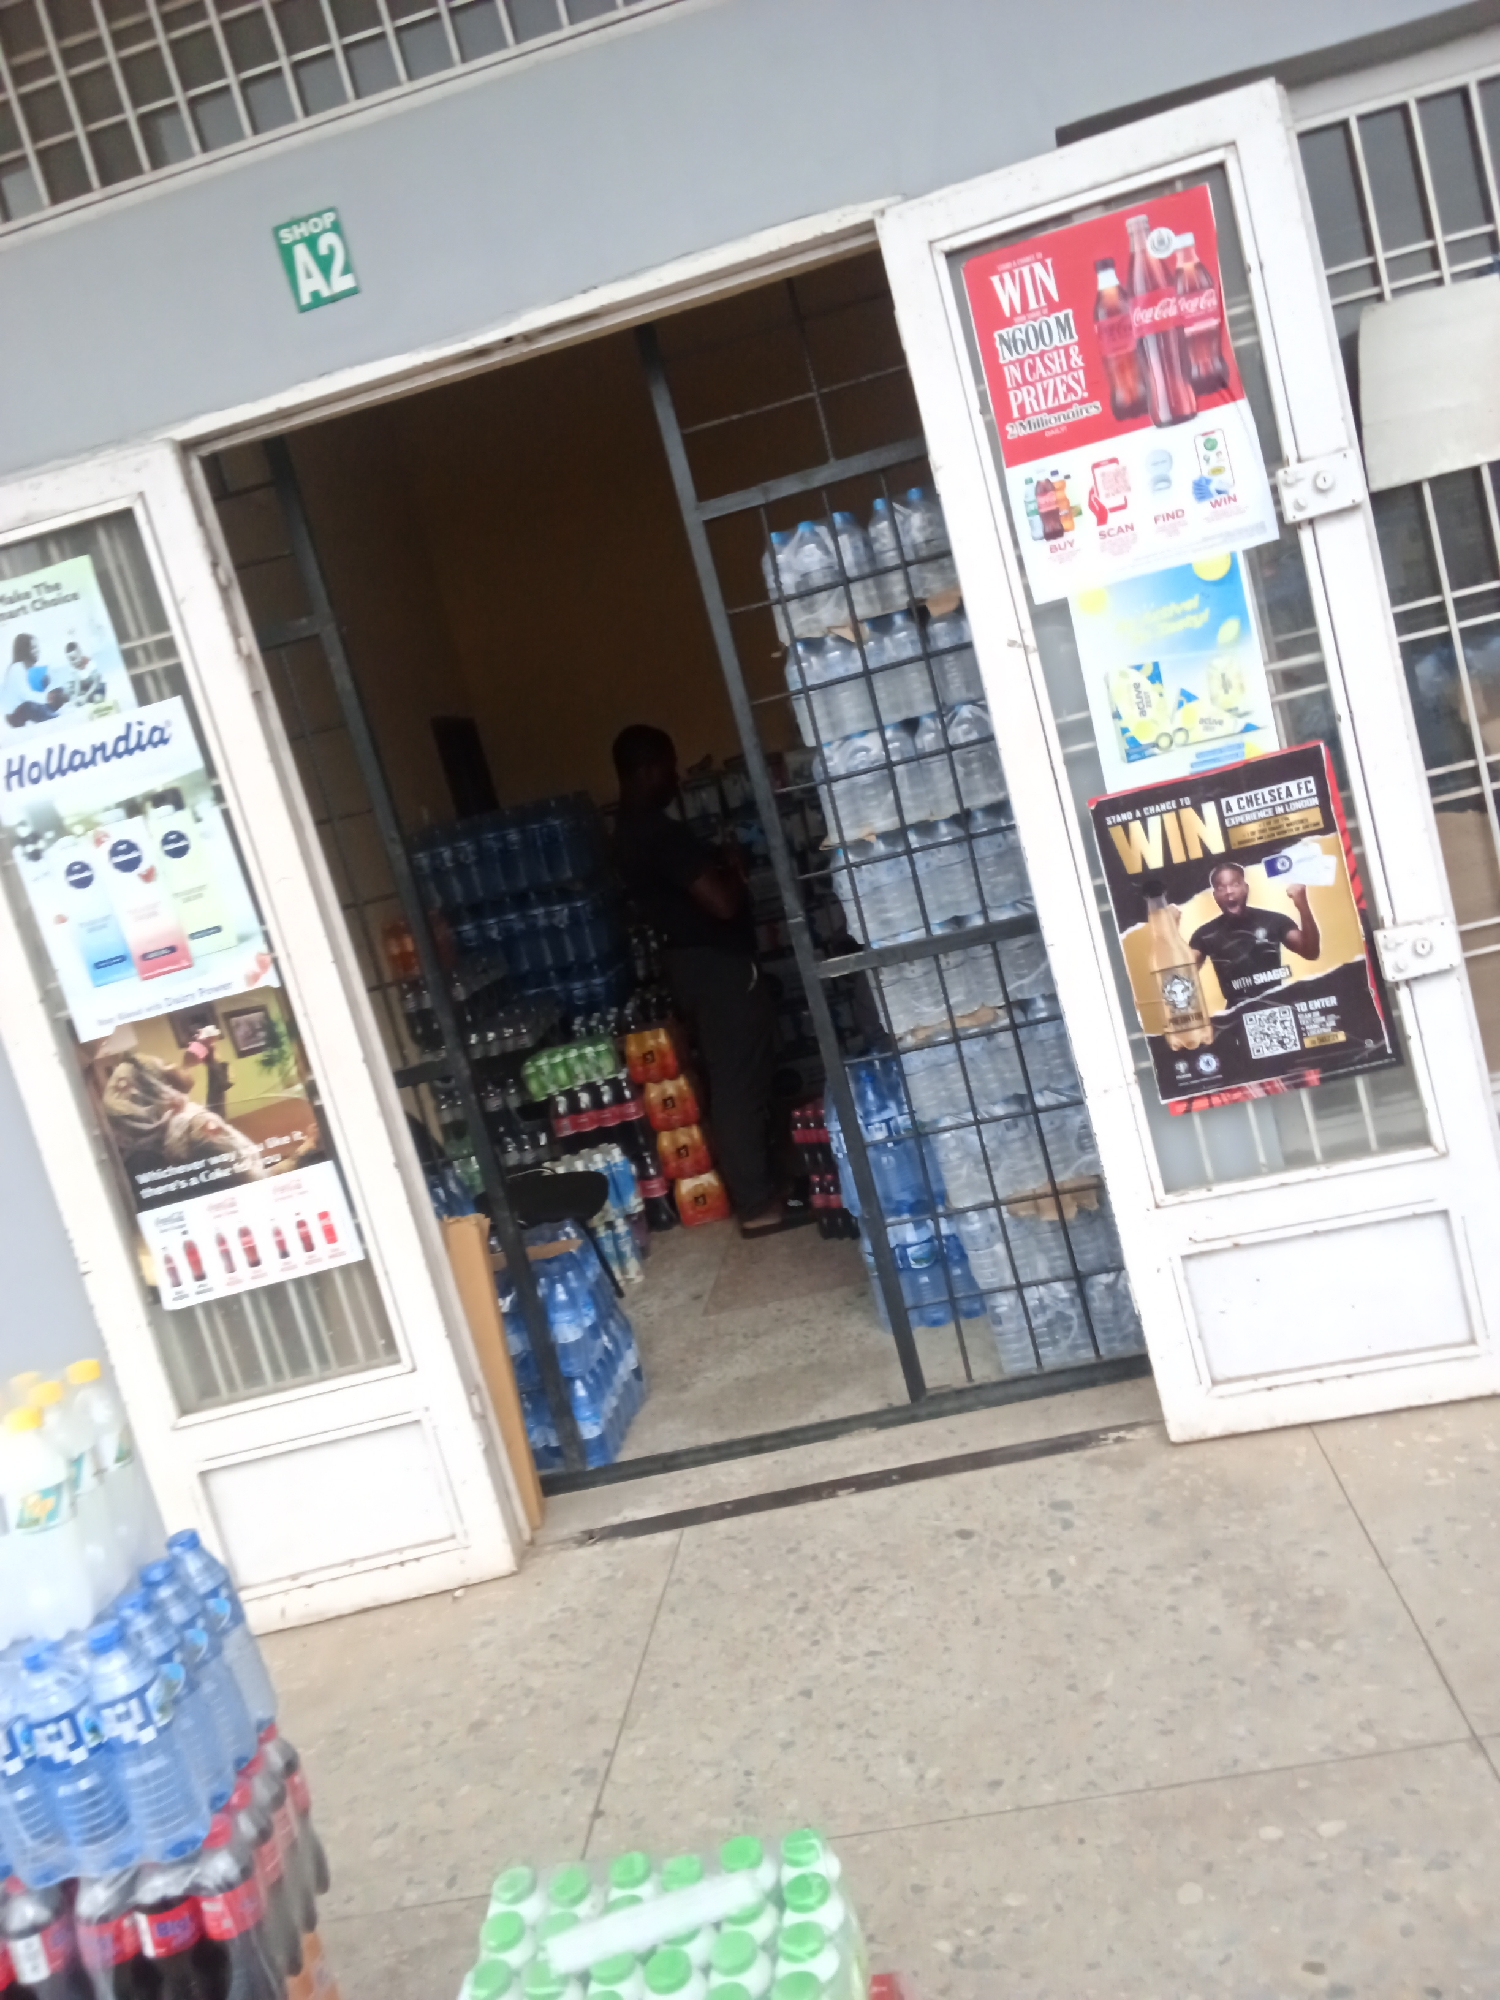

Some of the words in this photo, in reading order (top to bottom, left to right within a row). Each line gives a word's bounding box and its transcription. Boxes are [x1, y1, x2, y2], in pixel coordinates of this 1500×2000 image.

[278, 211, 336, 244] SHOP
[292, 231, 357, 305] A2
[989, 257, 1059, 318] WIN
[1003, 362, 1023, 389] IN
[1023, 348, 1069, 383] CASH
[1068, 344, 1085, 369] &
[1007, 368, 1089, 419] PRIZES!
[1017, 401, 1102, 436] Millionaires
[1153, 508, 1186, 525] FIND
[1209, 494, 1238, 509] WIN
[1049, 538, 1076, 554] BUY
[1098, 522, 1136, 540] SCAN
[5, 721, 171, 792] Hollandia
[1105, 811, 1133, 826] STAND
[1135, 809, 1142, 818] A
[1142, 800, 1177, 816] CHANCE
[1179, 796, 1191, 807] TO
[1224, 807, 1274, 828] EXPERIENCE
[1274, 804, 1285, 815] IN
[1284, 796, 1320, 812] LONDON
[1225, 800, 1234, 814] A
[1236, 785, 1293, 810] CHELSEA
[1296, 780, 1314, 796] FC
[1107, 800, 1226, 875] WIN
[1231, 976, 1253, 991] WITH
[1252, 966, 1291, 986] SHAGGI
[1294, 1001, 1308, 1013] TO
[1307, 995, 1338, 1011] ENTER
